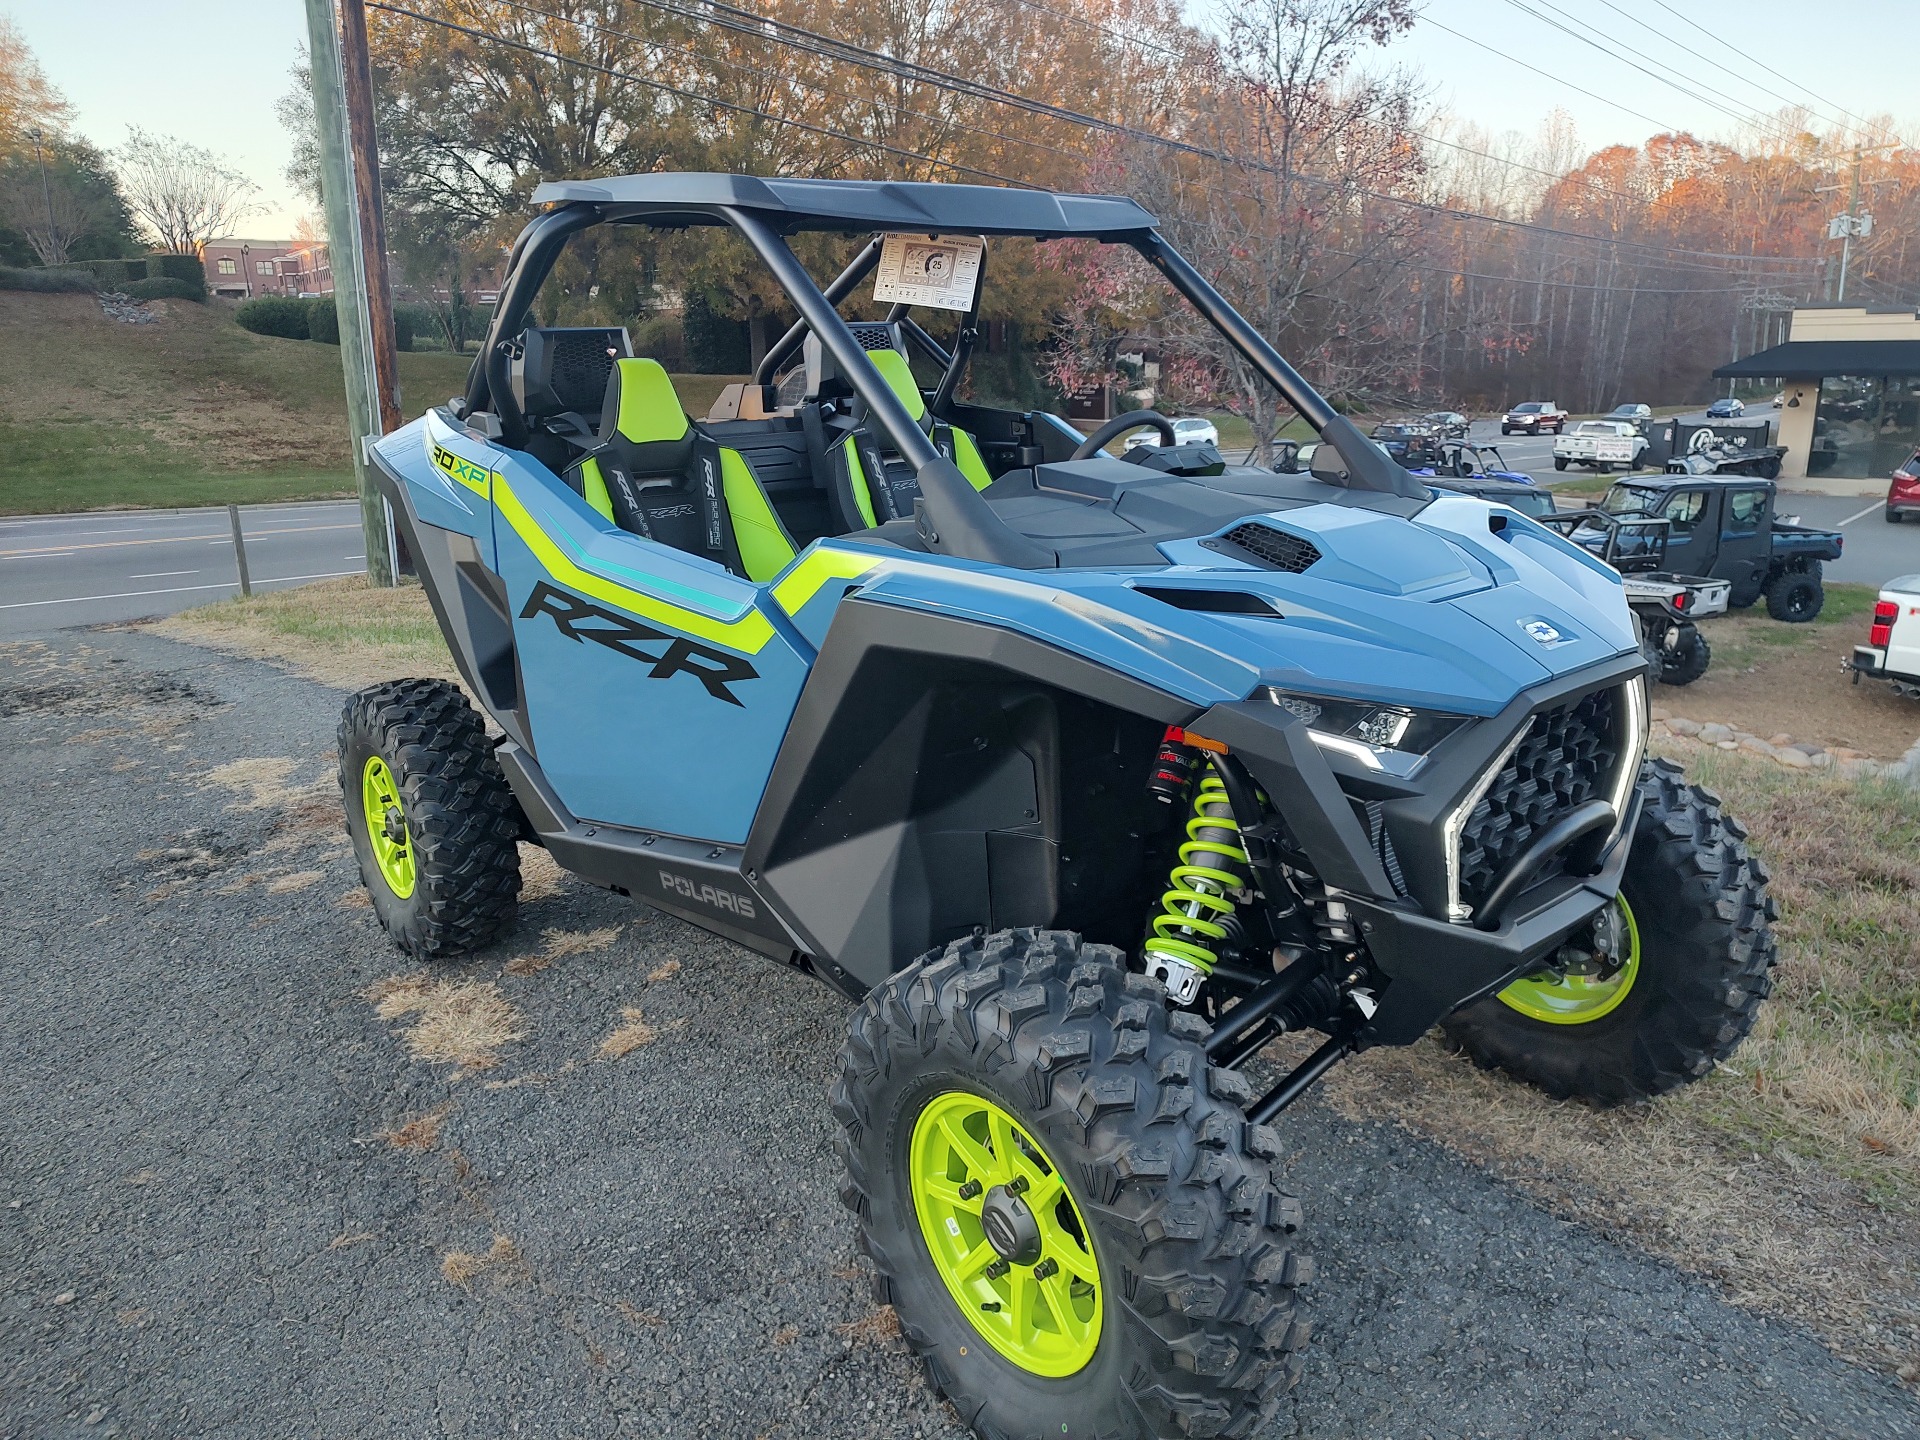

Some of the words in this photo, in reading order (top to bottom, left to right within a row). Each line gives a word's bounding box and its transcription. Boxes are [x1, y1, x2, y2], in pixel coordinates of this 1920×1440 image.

[932, 261, 942, 269] 25
[611, 469, 639, 510] RZR
[702, 457, 716, 498] RZR
[647, 503, 696, 518] RZR
[518, 579, 761, 709] RZR
[659, 869, 756, 918] POLARIS
